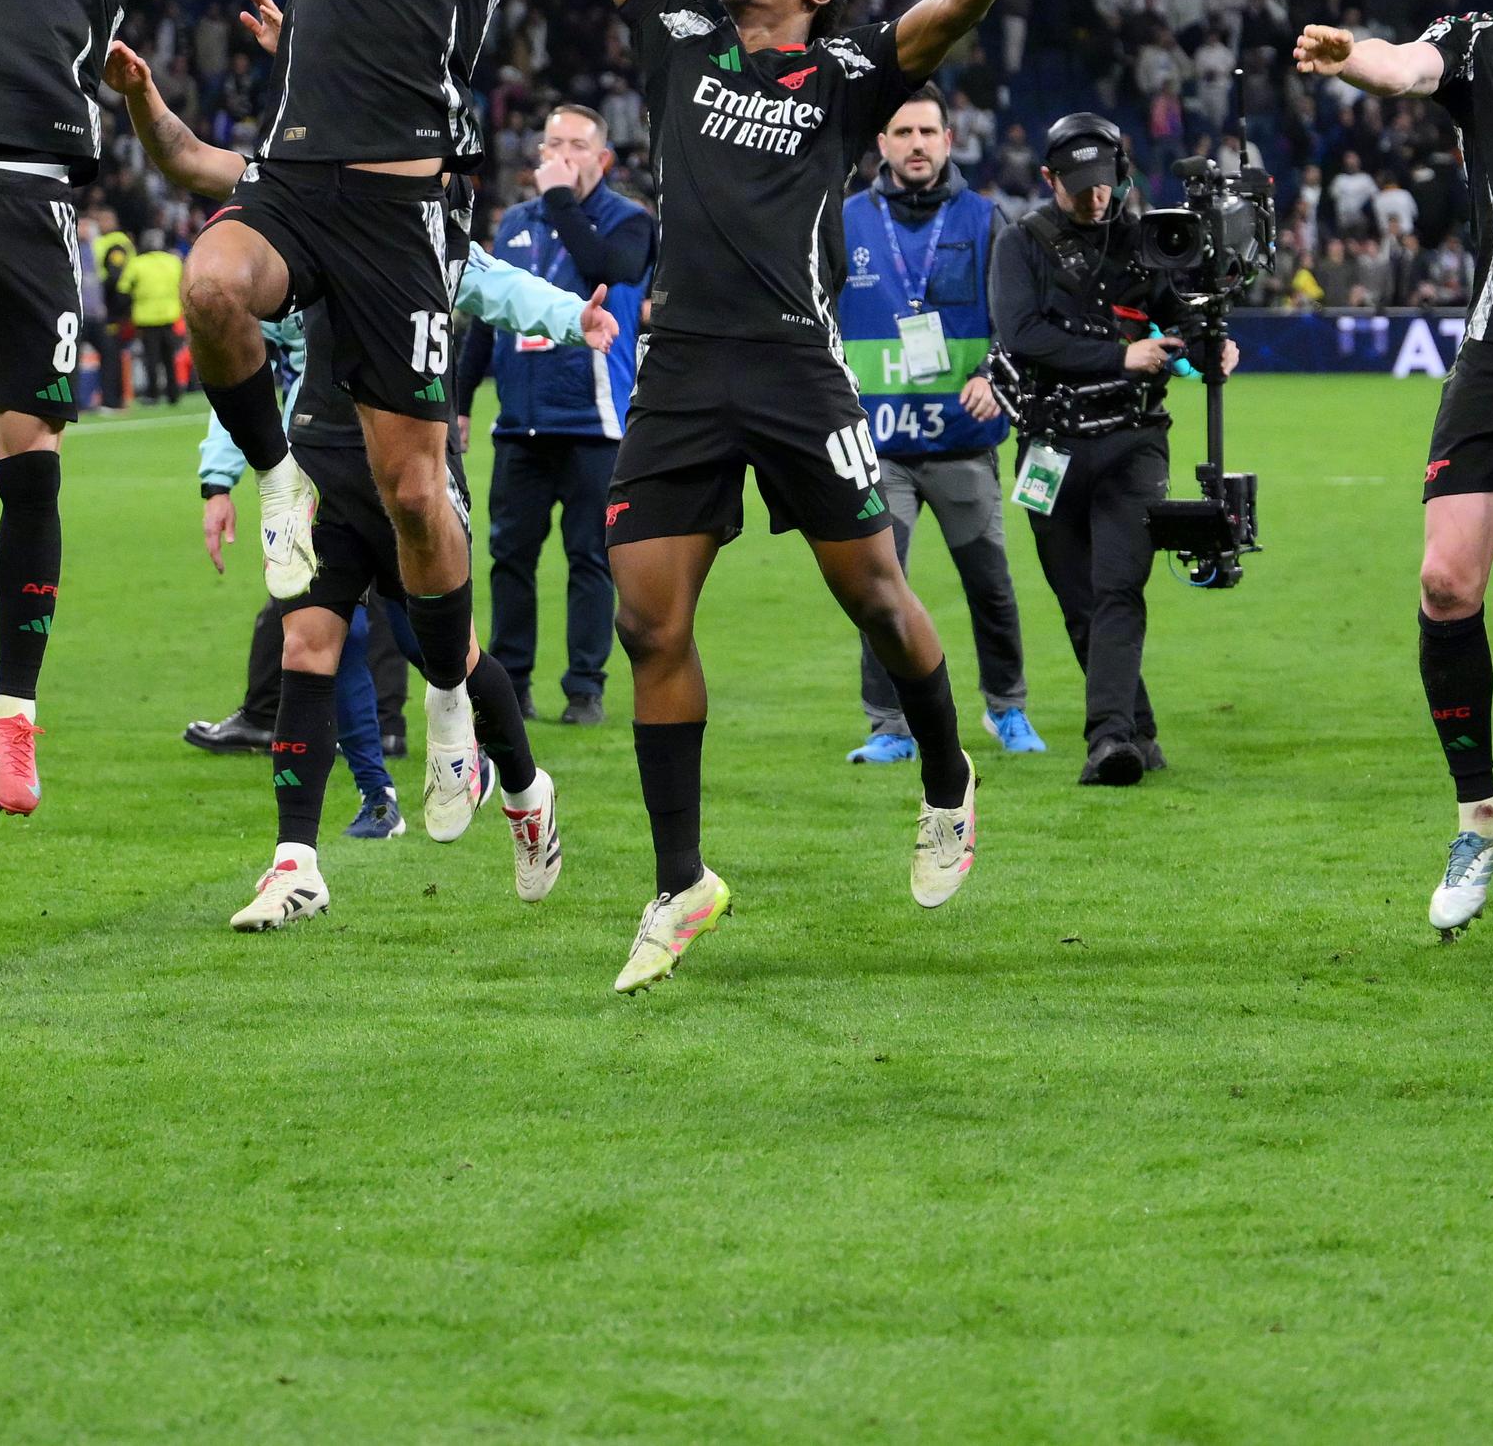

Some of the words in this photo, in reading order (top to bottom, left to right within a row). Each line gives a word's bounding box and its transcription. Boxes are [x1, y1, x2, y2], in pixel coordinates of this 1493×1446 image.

[692, 74, 826, 130] Emirates
[699, 111, 737, 142] FLY
[732, 120, 803, 157] BETTER
[51, 310, 79, 374] 8
[409, 309, 450, 376] 15
[874, 401, 946, 444] 043
[825, 417, 882, 491] 49
[1433, 704, 1473, 722] AFC
[270, 740, 308, 756] AFC
